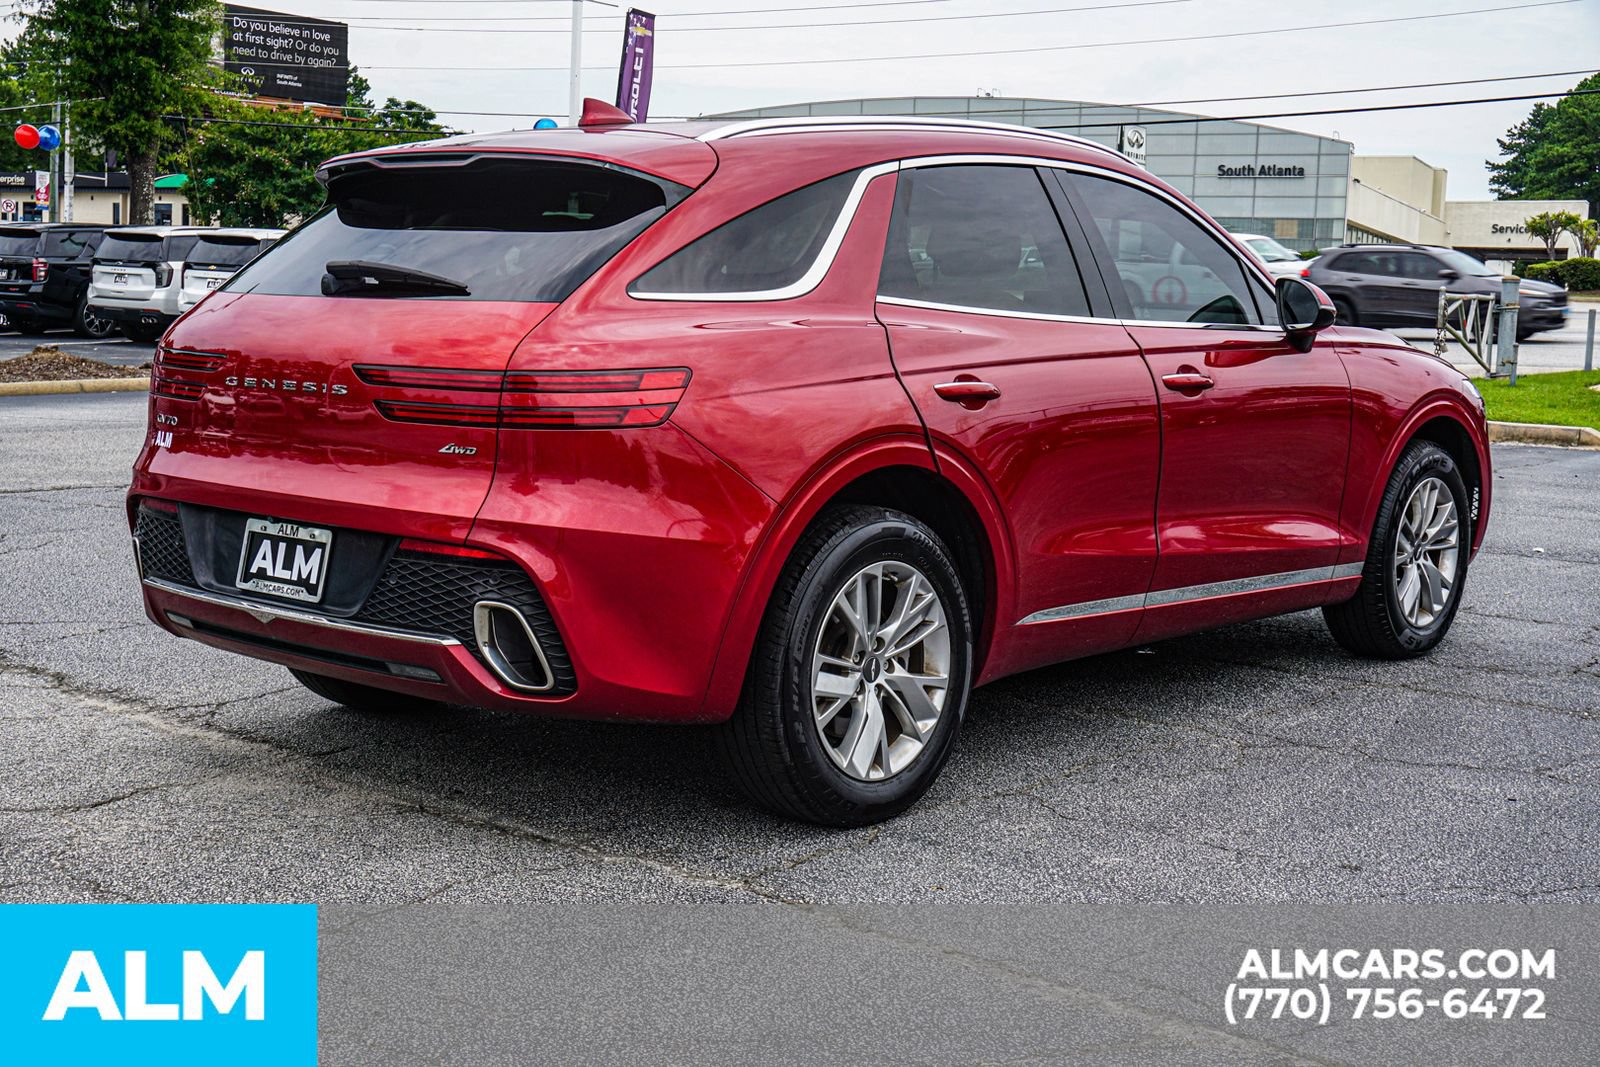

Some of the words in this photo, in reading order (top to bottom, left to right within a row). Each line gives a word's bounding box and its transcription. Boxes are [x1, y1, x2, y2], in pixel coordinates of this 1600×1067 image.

[233, 16, 248, 29] Do
[250, 21, 267, 33] you
[269, 22, 300, 37] believe
[302, 27, 310, 38] in
[312, 29, 331, 42] love
[232, 32, 243, 42] at
[245, 32, 264, 45] first
[266, 36, 294, 50] sight?
[295, 40, 308, 50] Or
[309, 42, 321, 53] do
[323, 46, 339, 56] you
[232, 46, 256, 57] need
[258, 49, 269, 59] to
[270, 50, 293, 62] drive
[294, 52, 306, 66] by
[307, 57, 337, 68] again?
[1218, 164, 1255, 176] South
[1258, 164, 1305, 176] Atlanta
[225, 376, 348, 395] GENESIS
[155, 430, 173, 449] ALM
[277, 524, 300, 537] ALM
[249, 539, 322, 585] ALM
[255, 583, 301, 597] ALMCARS.COM
